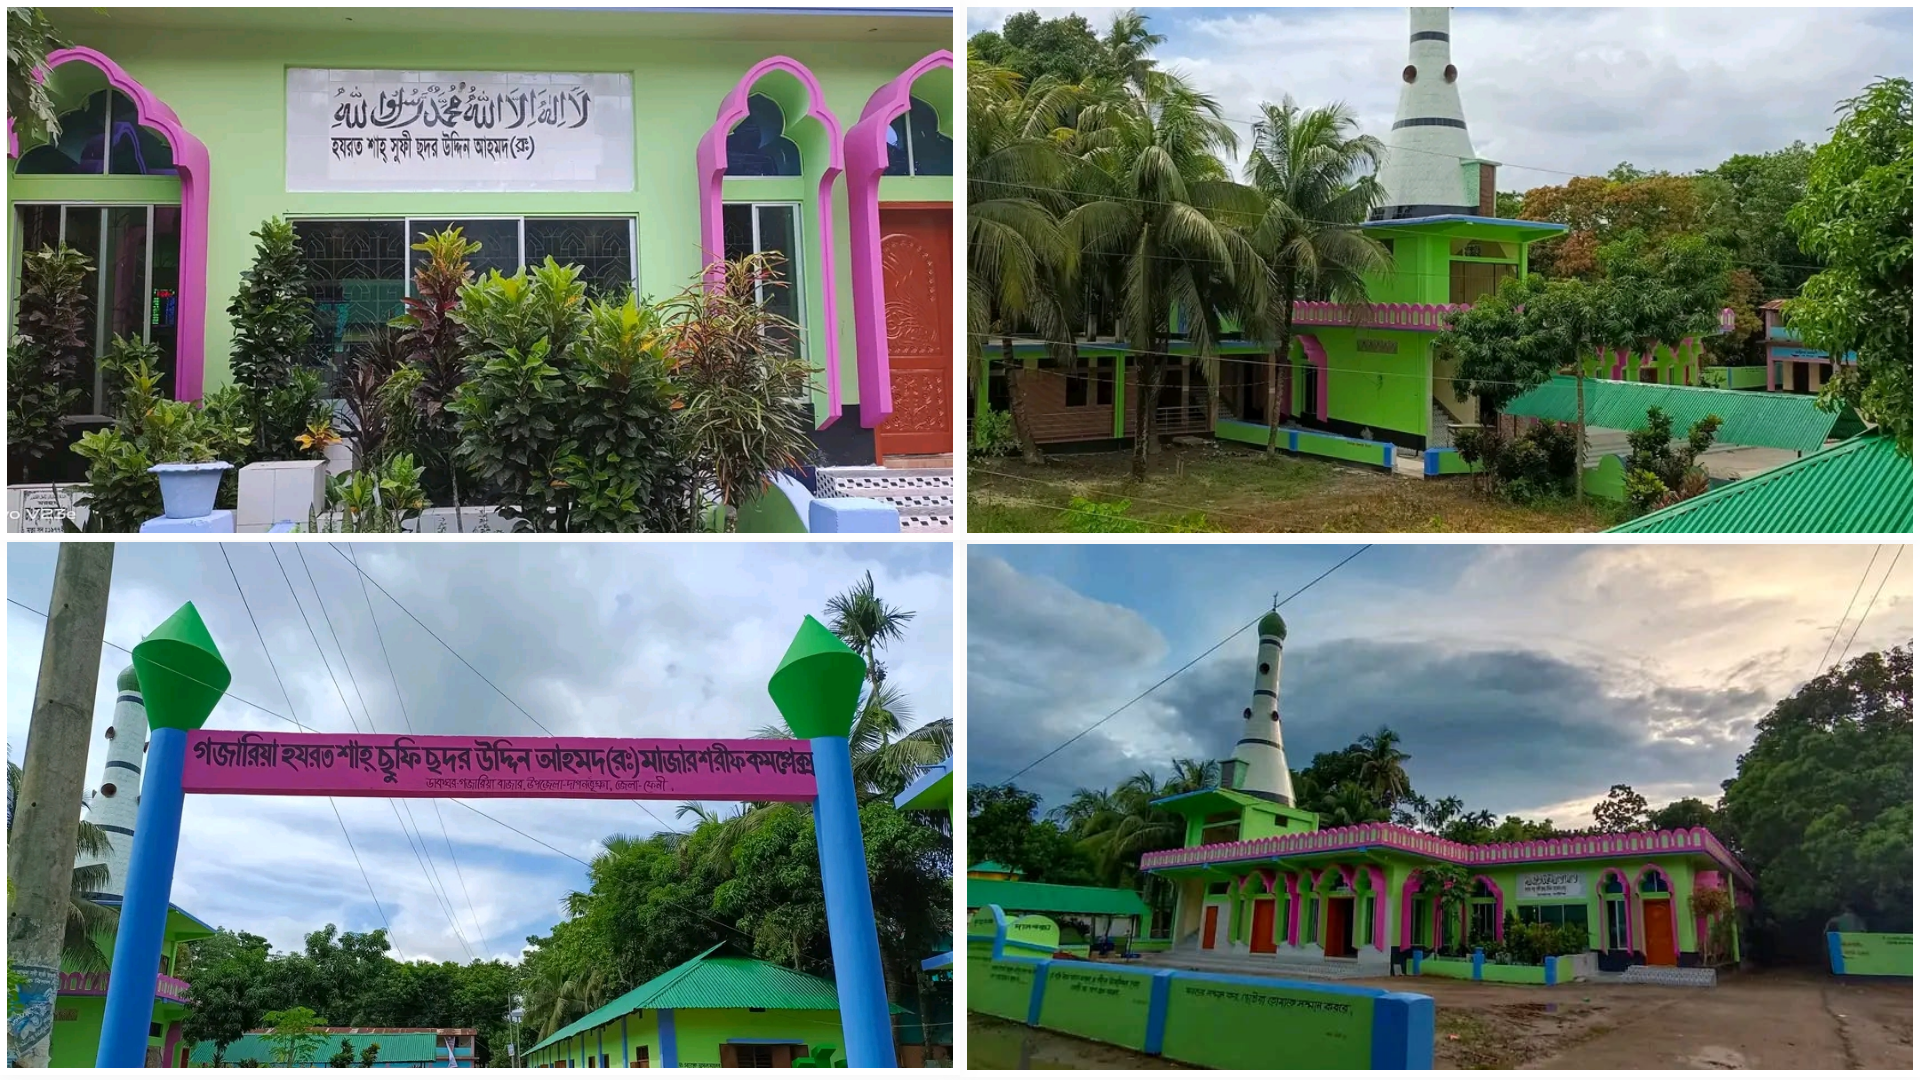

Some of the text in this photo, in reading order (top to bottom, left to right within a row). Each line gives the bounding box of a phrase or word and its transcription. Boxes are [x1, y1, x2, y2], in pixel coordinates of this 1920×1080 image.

[331, 137, 363, 161] হযরত
[415, 138, 438, 161] ছদর
[441, 130, 470, 159] উদ্দিন
[193, 734, 277, 768] গজারিয়া
[281, 743, 333, 772] হযরত
[374, 737, 422, 783] ছুফি
[421, 747, 473, 774] ছদর
[475, 739, 533, 775] উদ্দিন
[638, 744, 698, 774] মাজার
[698, 742, 746, 774] শরীফ
